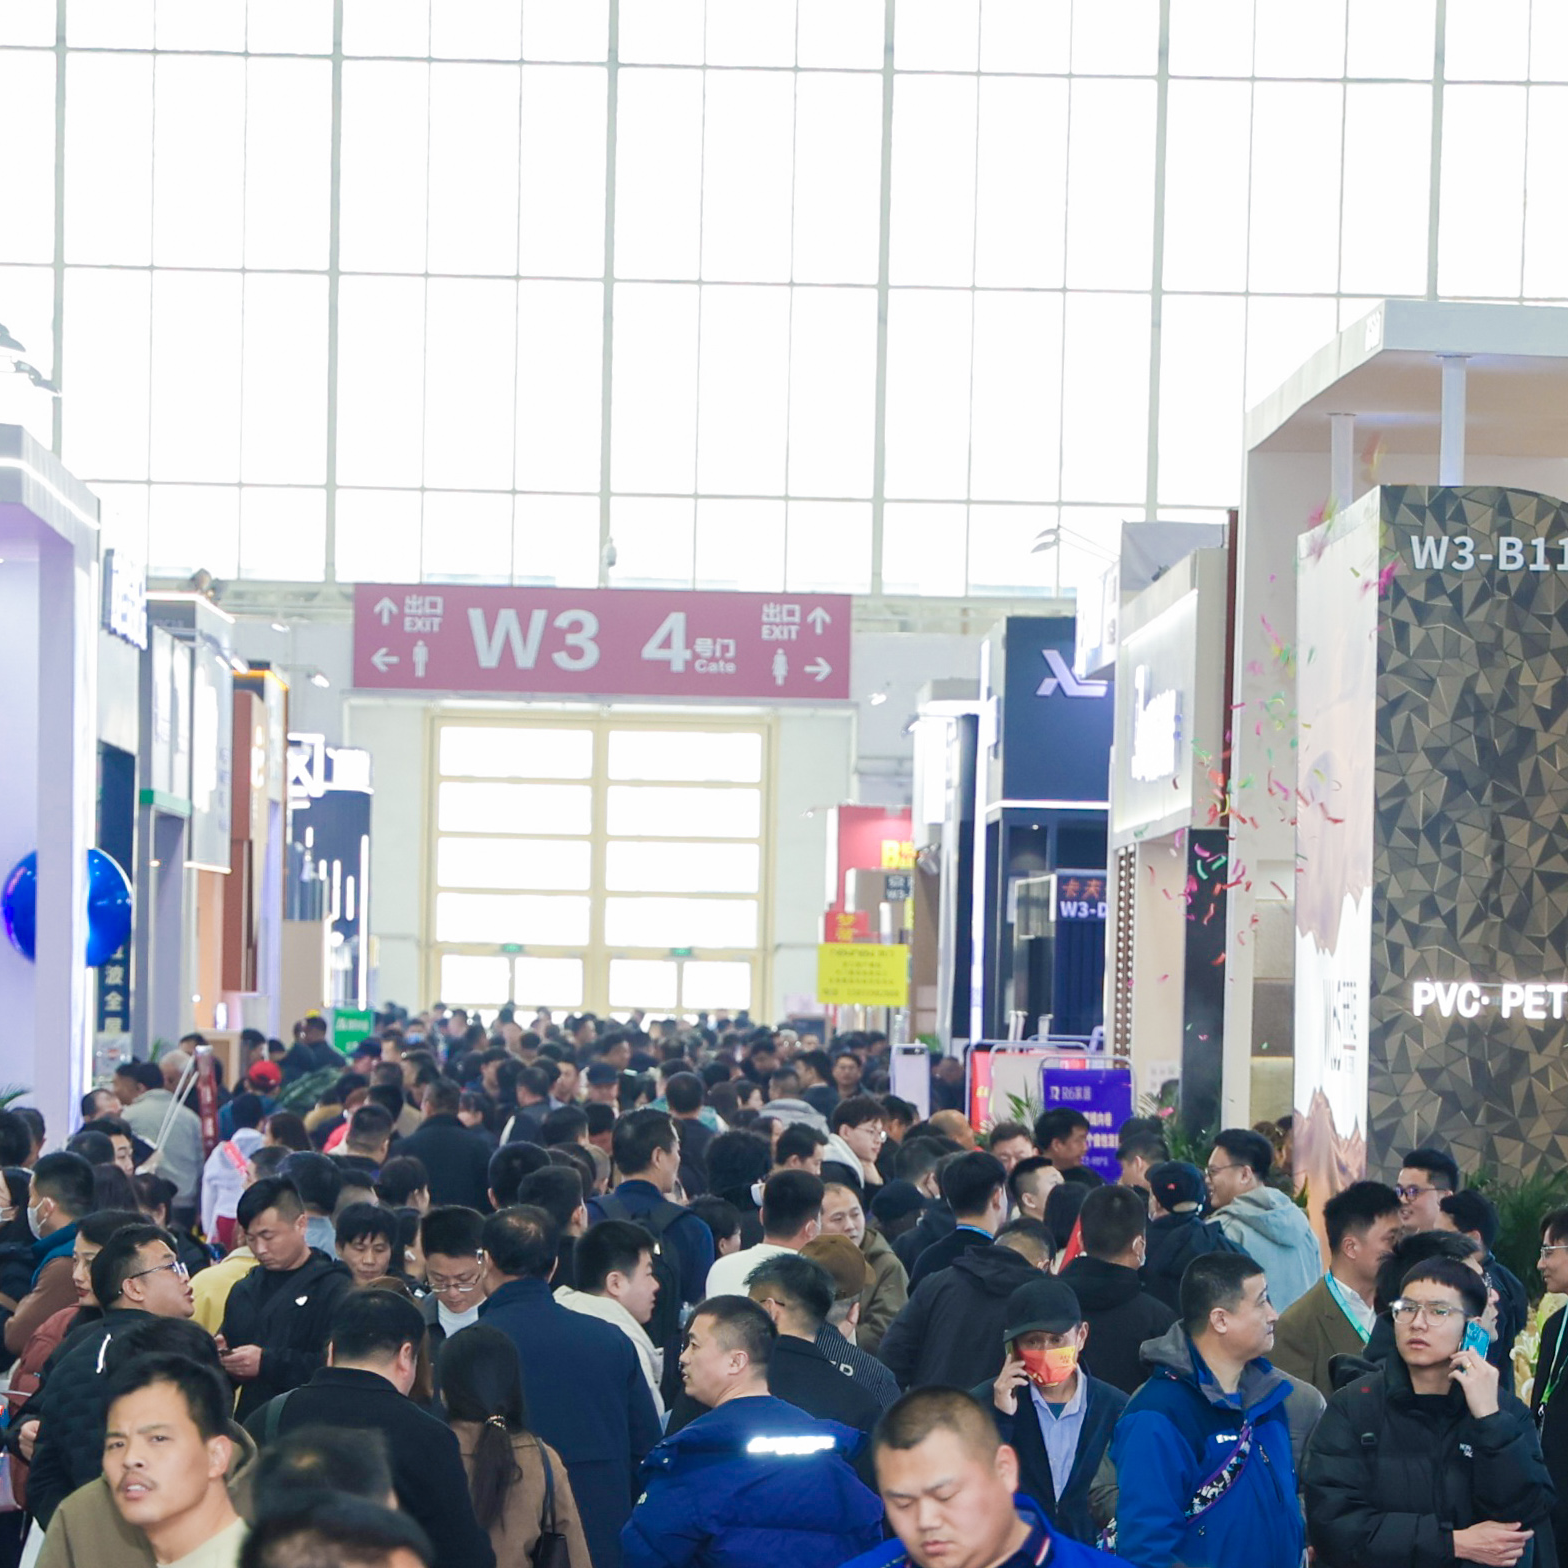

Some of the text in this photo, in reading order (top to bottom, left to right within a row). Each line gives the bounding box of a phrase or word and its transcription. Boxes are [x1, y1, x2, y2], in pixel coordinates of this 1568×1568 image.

[404, 594, 444, 615] 出口
[761, 603, 801, 624] 出口
[404, 616, 443, 633] EXIT
[761, 625, 800, 640] EXIT
[467, 608, 600, 671] W3
[641, 612, 736, 673] 4 号门
